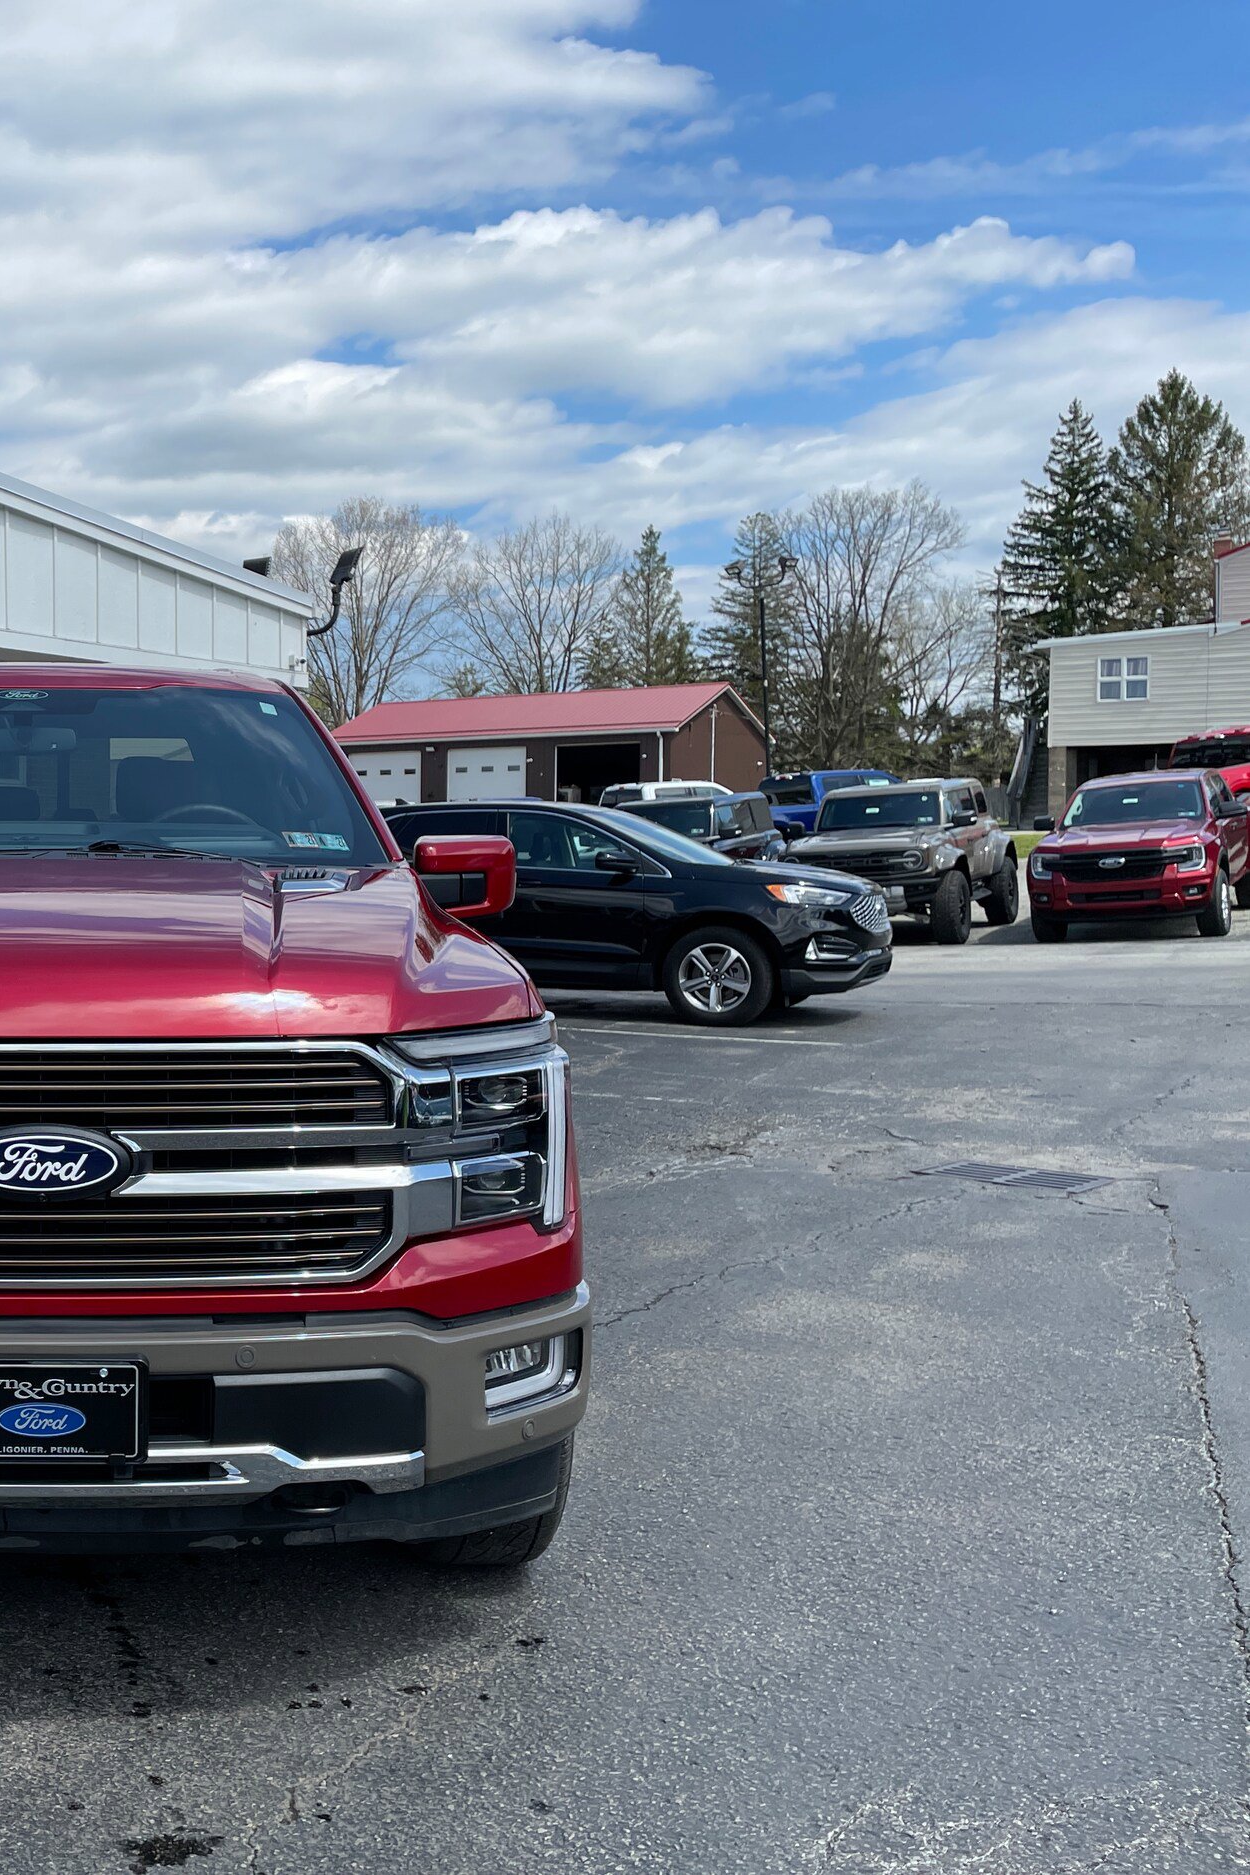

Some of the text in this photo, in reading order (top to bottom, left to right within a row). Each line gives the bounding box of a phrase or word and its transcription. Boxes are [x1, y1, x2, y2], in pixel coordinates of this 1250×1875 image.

[14, 1381, 45, 1399] &
[41, 1379, 135, 1396] Country
[14, 1408, 69, 1431] Ford
[50, 1446, 89, 1454] PENNA.
